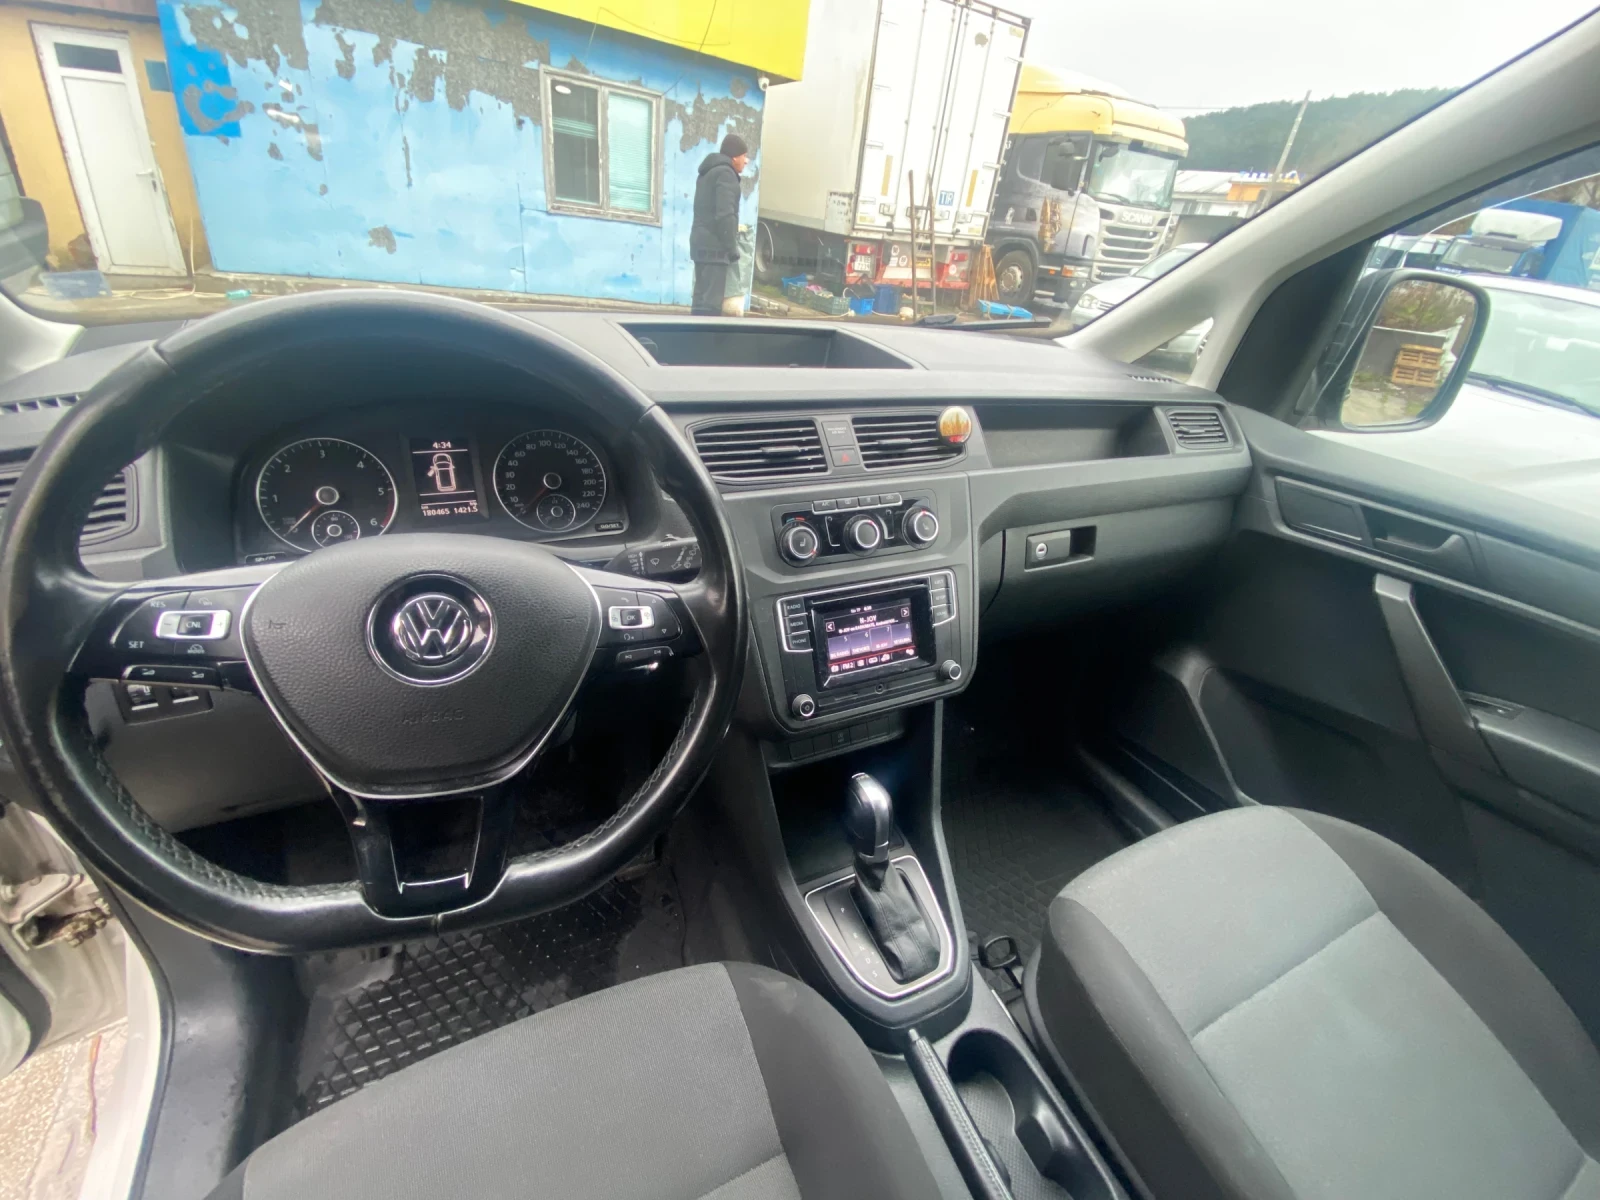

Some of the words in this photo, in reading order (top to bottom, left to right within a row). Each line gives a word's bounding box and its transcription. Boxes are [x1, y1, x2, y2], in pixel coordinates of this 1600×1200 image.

[940, 192, 953, 204] TIR
[1122, 210, 1153, 225] SCANIA
[432, 441, 452, 449] 4:34
[319, 450, 326, 459] 3
[284, 464, 292, 473] 2
[356, 461, 365, 469] 4
[378, 487, 385, 496] 5
[272, 494, 278, 503] 1
[422, 508, 450, 516] 180465
[453, 506, 478, 514] 1421.5
[370, 518, 378, 526] 6
[859, 615, 877, 623] N-JOY
[128, 641, 144, 649] SET
[402, 708, 465, 724] AIRBAG
